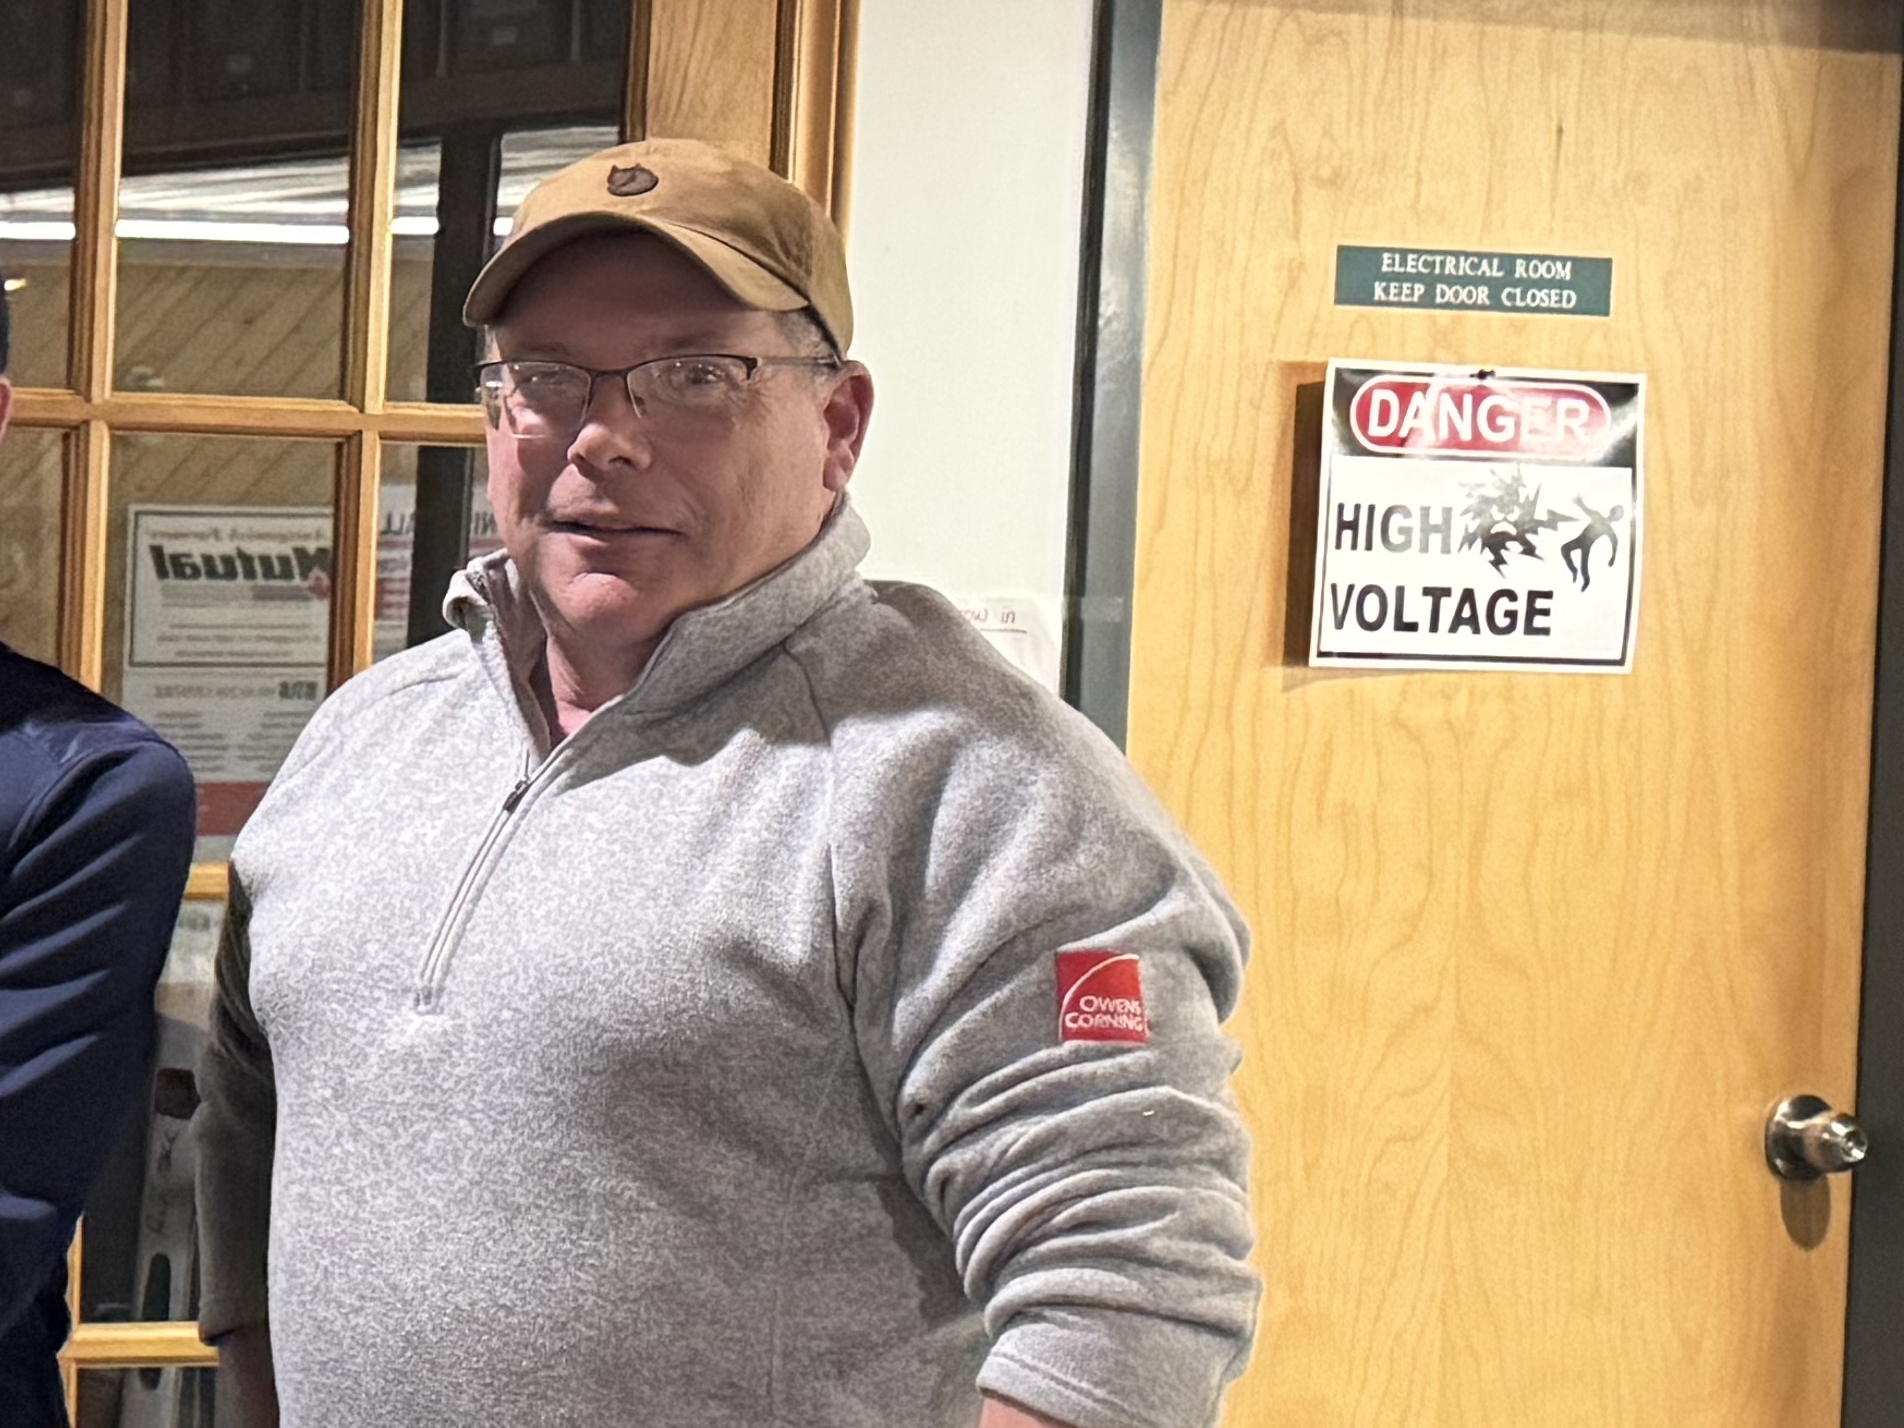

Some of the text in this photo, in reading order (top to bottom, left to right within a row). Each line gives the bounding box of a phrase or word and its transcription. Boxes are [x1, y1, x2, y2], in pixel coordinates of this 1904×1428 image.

[1380, 252, 1573, 281] ELECTRICAL ROOM
[1373, 281, 1577, 309] KEEP DOOR CLOSED
[1367, 388, 1592, 445] DANGER
[1334, 502, 1453, 555] HIGH
[1330, 582, 1554, 637] VOLTAGE
[1079, 995, 1142, 1015] OWENS
[1064, 1011, 1144, 1033] CORNING
